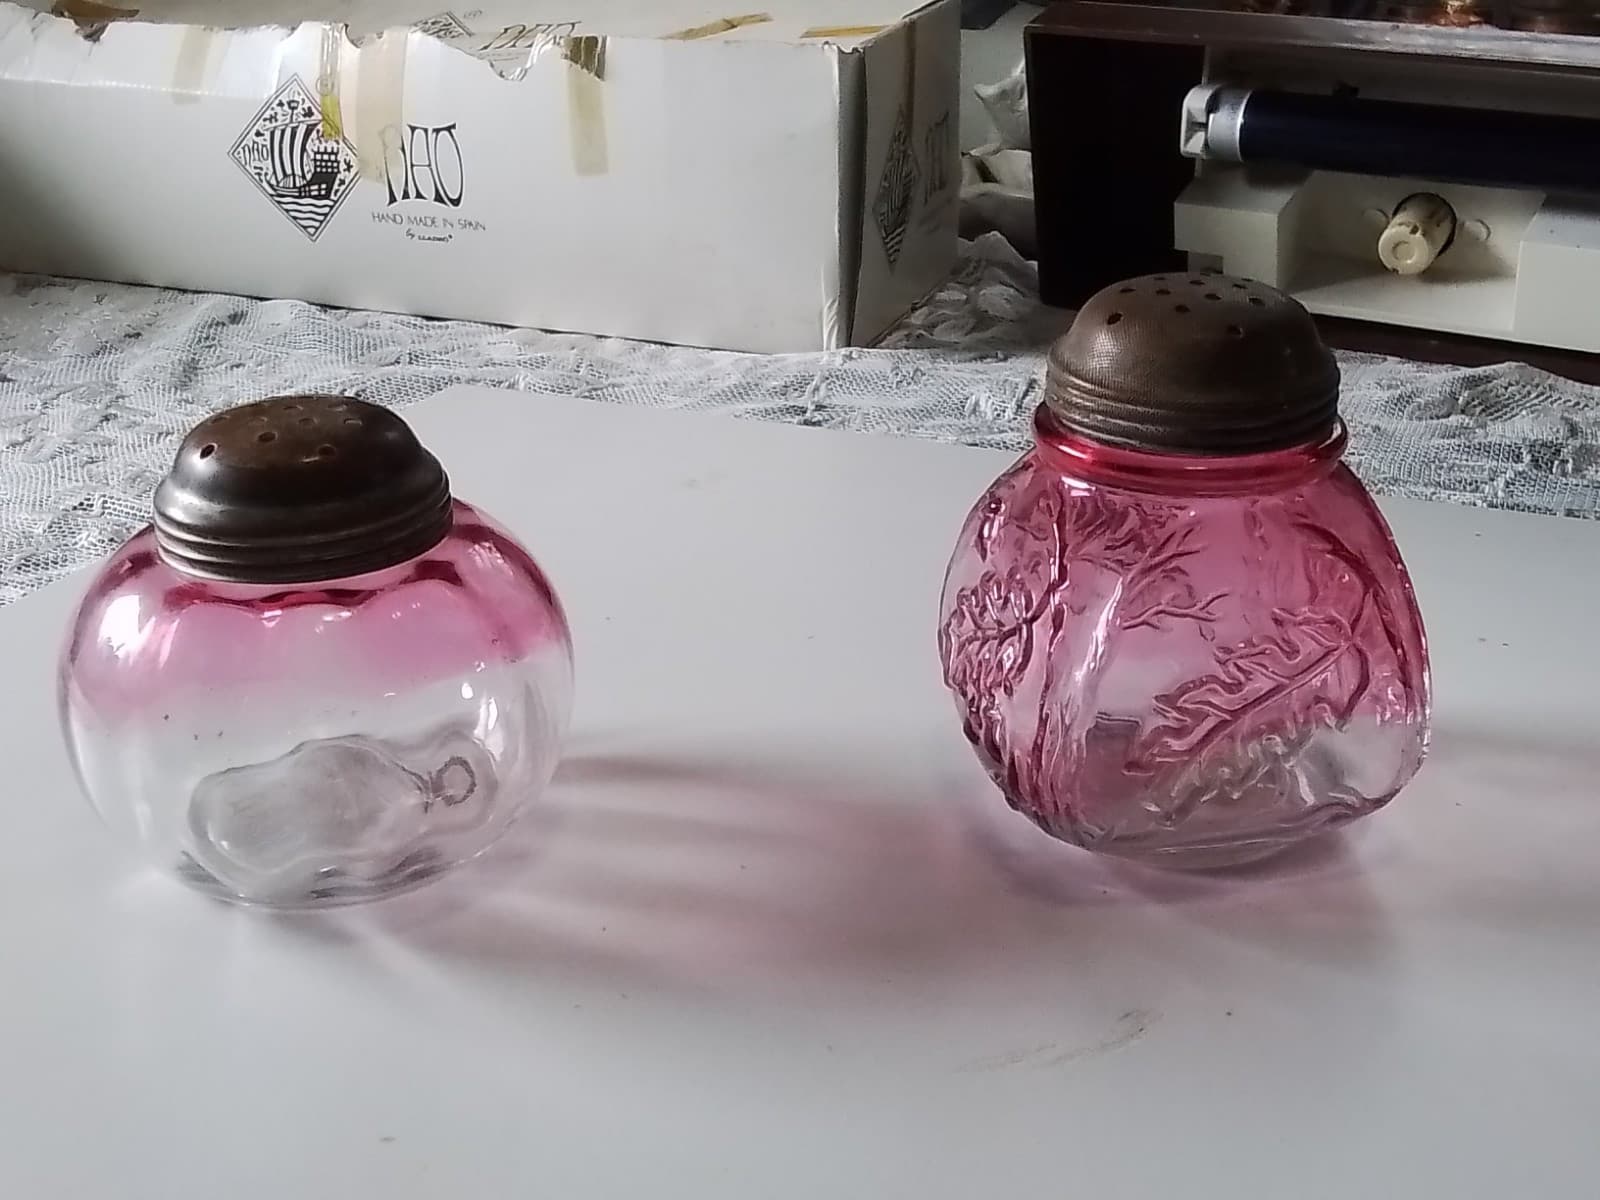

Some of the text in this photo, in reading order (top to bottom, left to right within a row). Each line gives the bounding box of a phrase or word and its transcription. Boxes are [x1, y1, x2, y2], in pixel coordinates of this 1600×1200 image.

[371, 211, 486, 232] HAND MADE IN SPAIN
